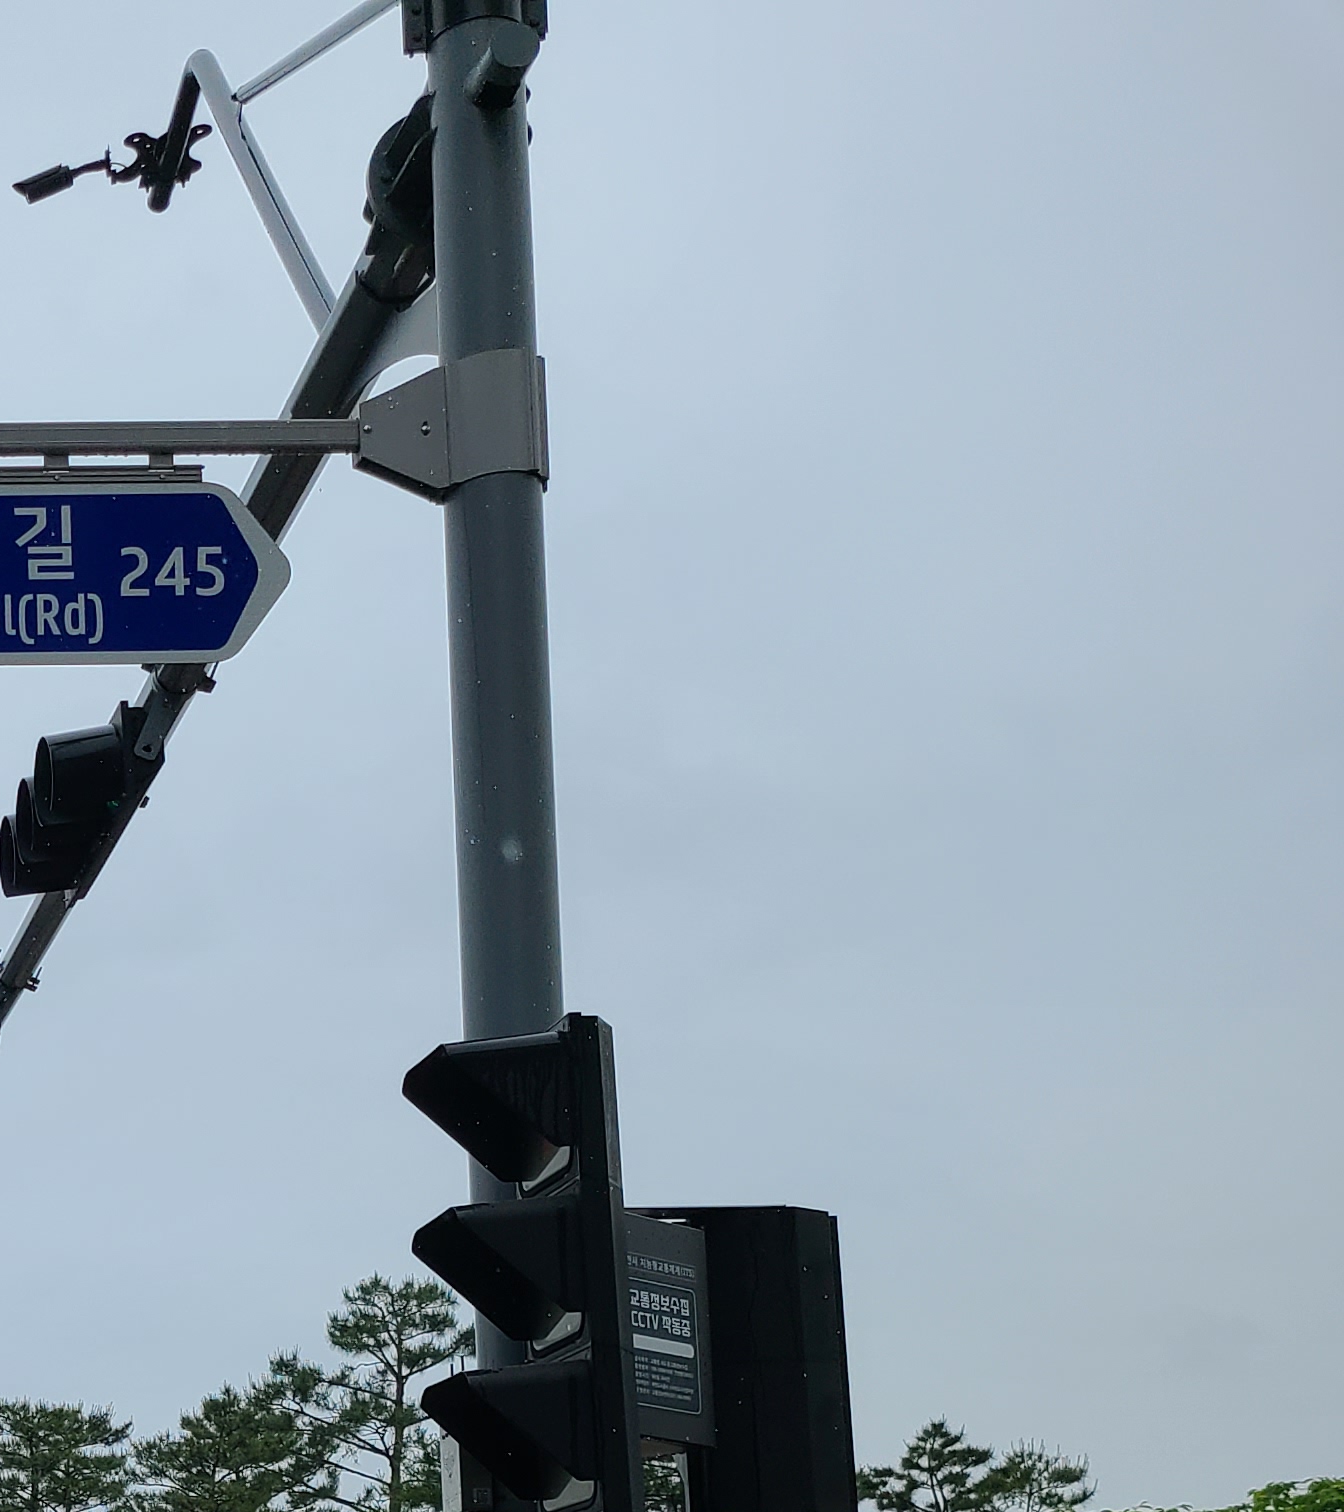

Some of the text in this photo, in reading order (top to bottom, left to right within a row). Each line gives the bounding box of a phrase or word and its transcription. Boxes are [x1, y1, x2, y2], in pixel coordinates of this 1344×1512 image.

[119, 545, 226, 598] 245
[628, 1288, 691, 1317] 교통정보수집
[631, 1310, 692, 1338] CCTV 작동중
